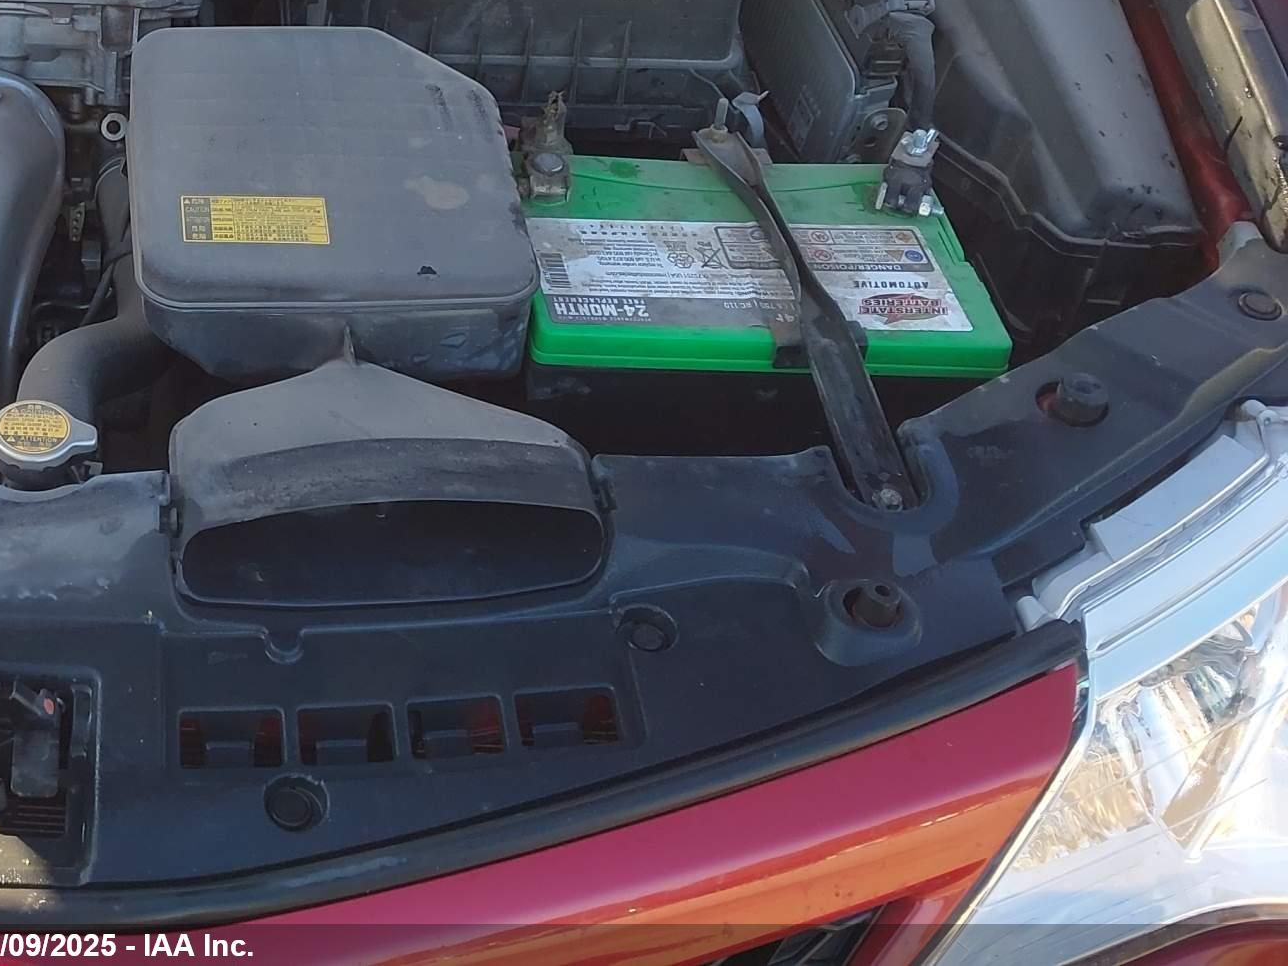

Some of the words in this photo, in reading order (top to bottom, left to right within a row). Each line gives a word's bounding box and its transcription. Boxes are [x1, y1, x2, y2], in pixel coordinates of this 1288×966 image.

[813, 263, 902, 271] DANGER/POISON
[853, 280, 929, 290] AUTOMOTIVE
[552, 296, 618, 304] REPLACEMENT
[861, 299, 942, 307] BATTERIES
[739, 301, 752, 309] RC
[553, 302, 650, 317] 24-MONTH
[858, 305, 948, 316] INTERSTATE
